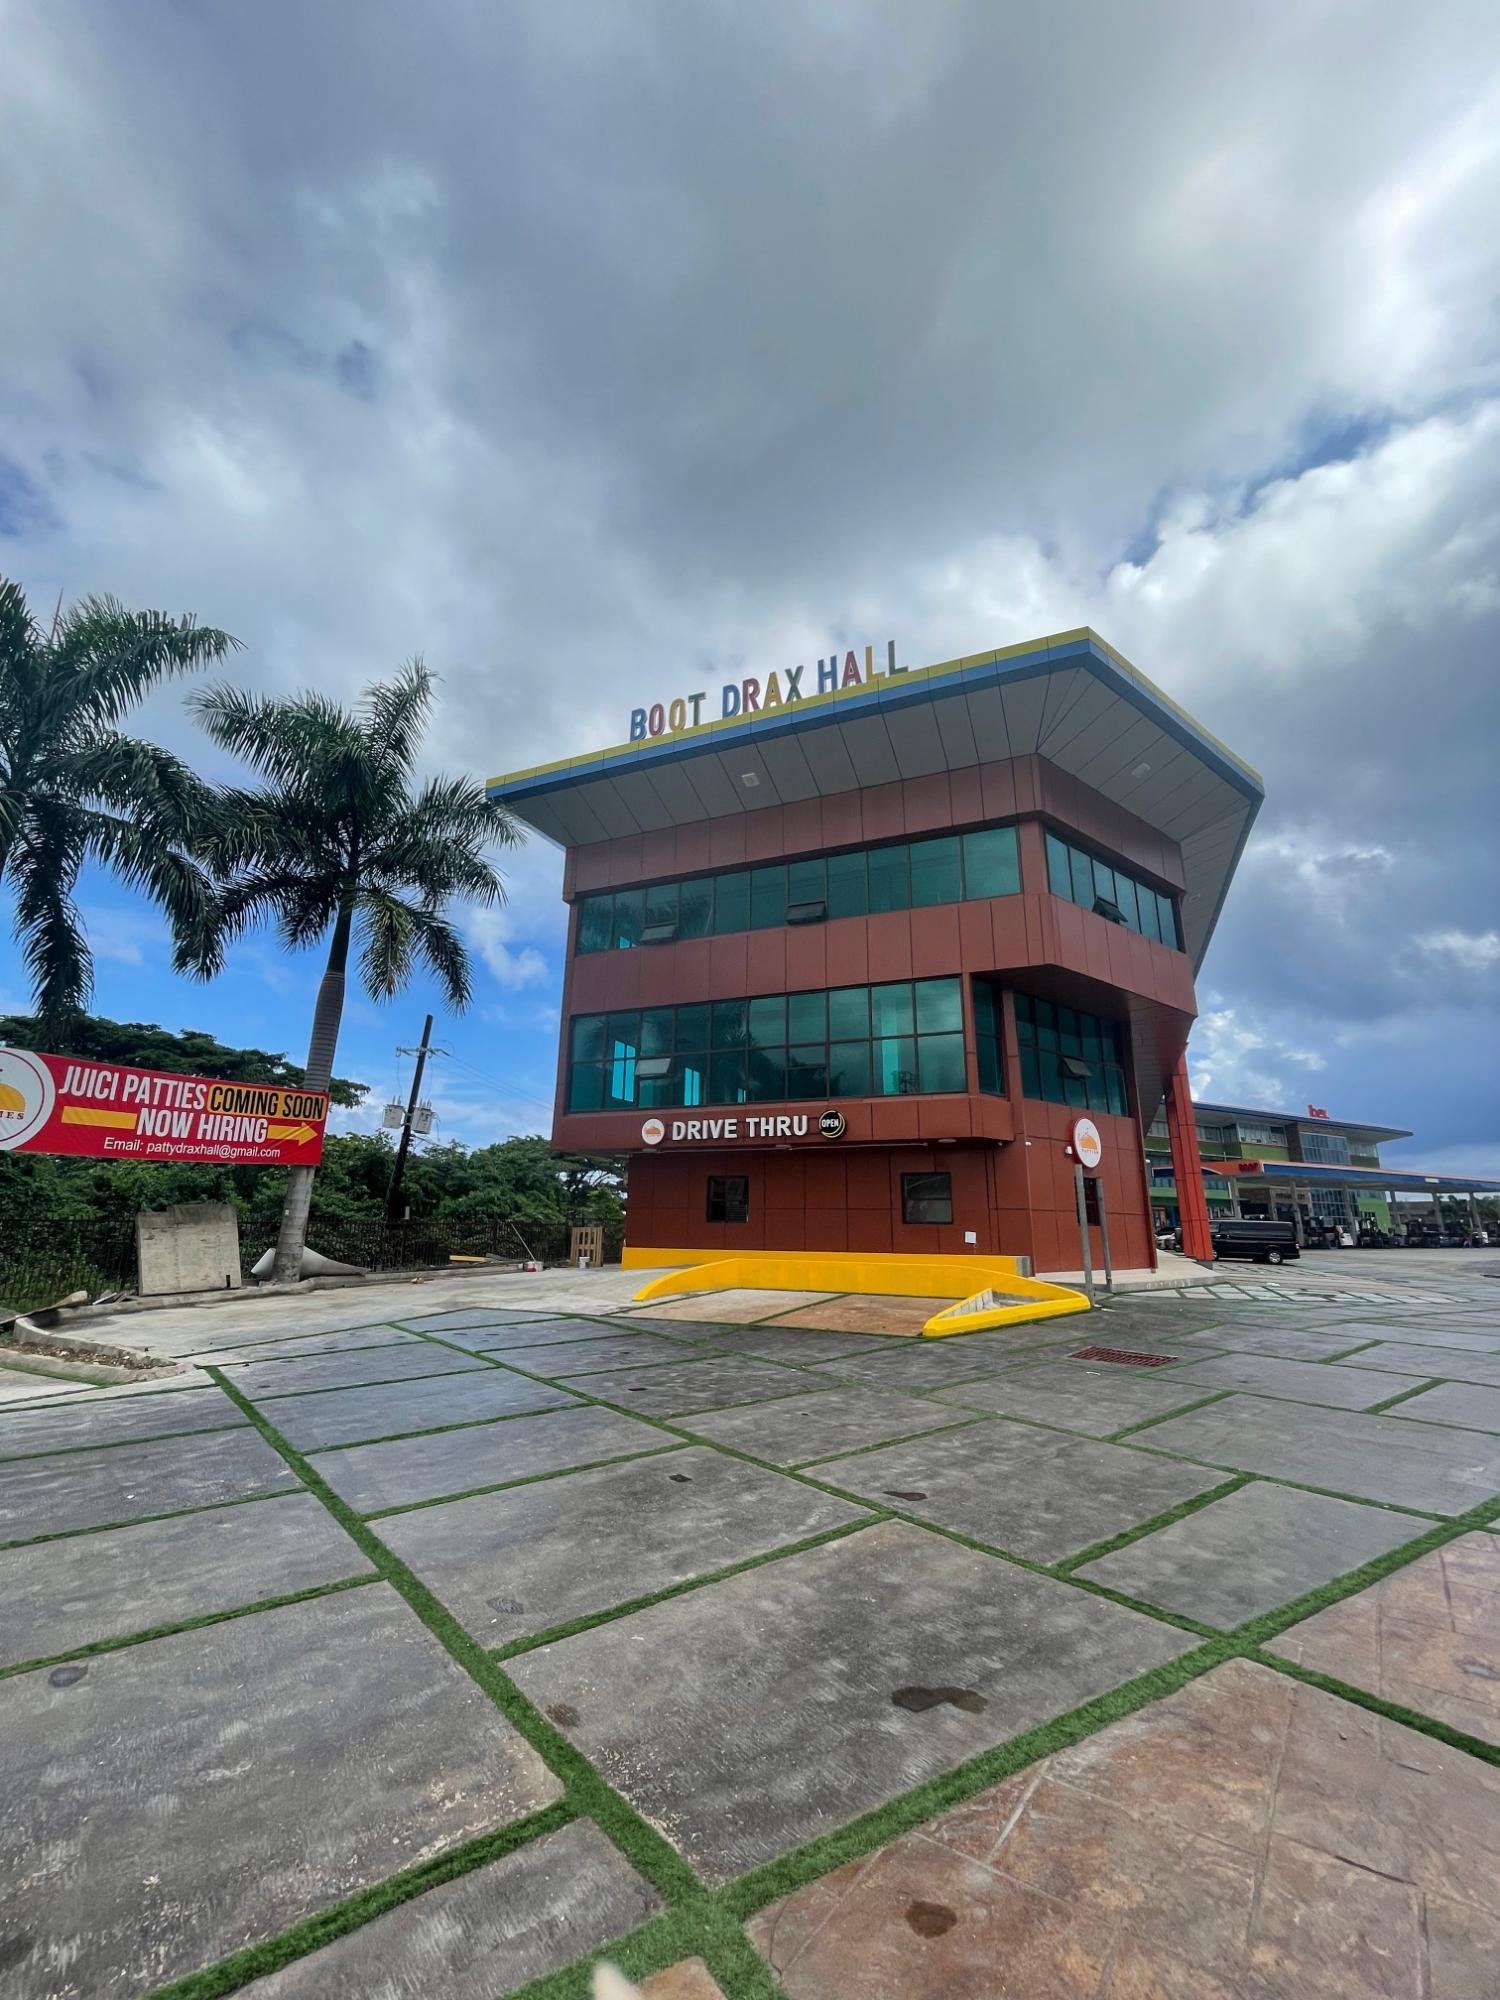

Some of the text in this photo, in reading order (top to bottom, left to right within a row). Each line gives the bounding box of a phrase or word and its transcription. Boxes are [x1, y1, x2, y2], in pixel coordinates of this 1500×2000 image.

[630, 640, 909, 742] BOOT DRAX HALL
[58, 1065, 207, 1110] JUICI PATTIES
[210, 1086, 324, 1119] COMING SOON
[137, 1107, 268, 1143] NOW HIRING
[672, 1115, 808, 1140] DRIVE THRU
[821, 1118, 839, 1128] OPEN
[104, 1137, 281, 1158] Email: pattydraxhall@gmail.com
